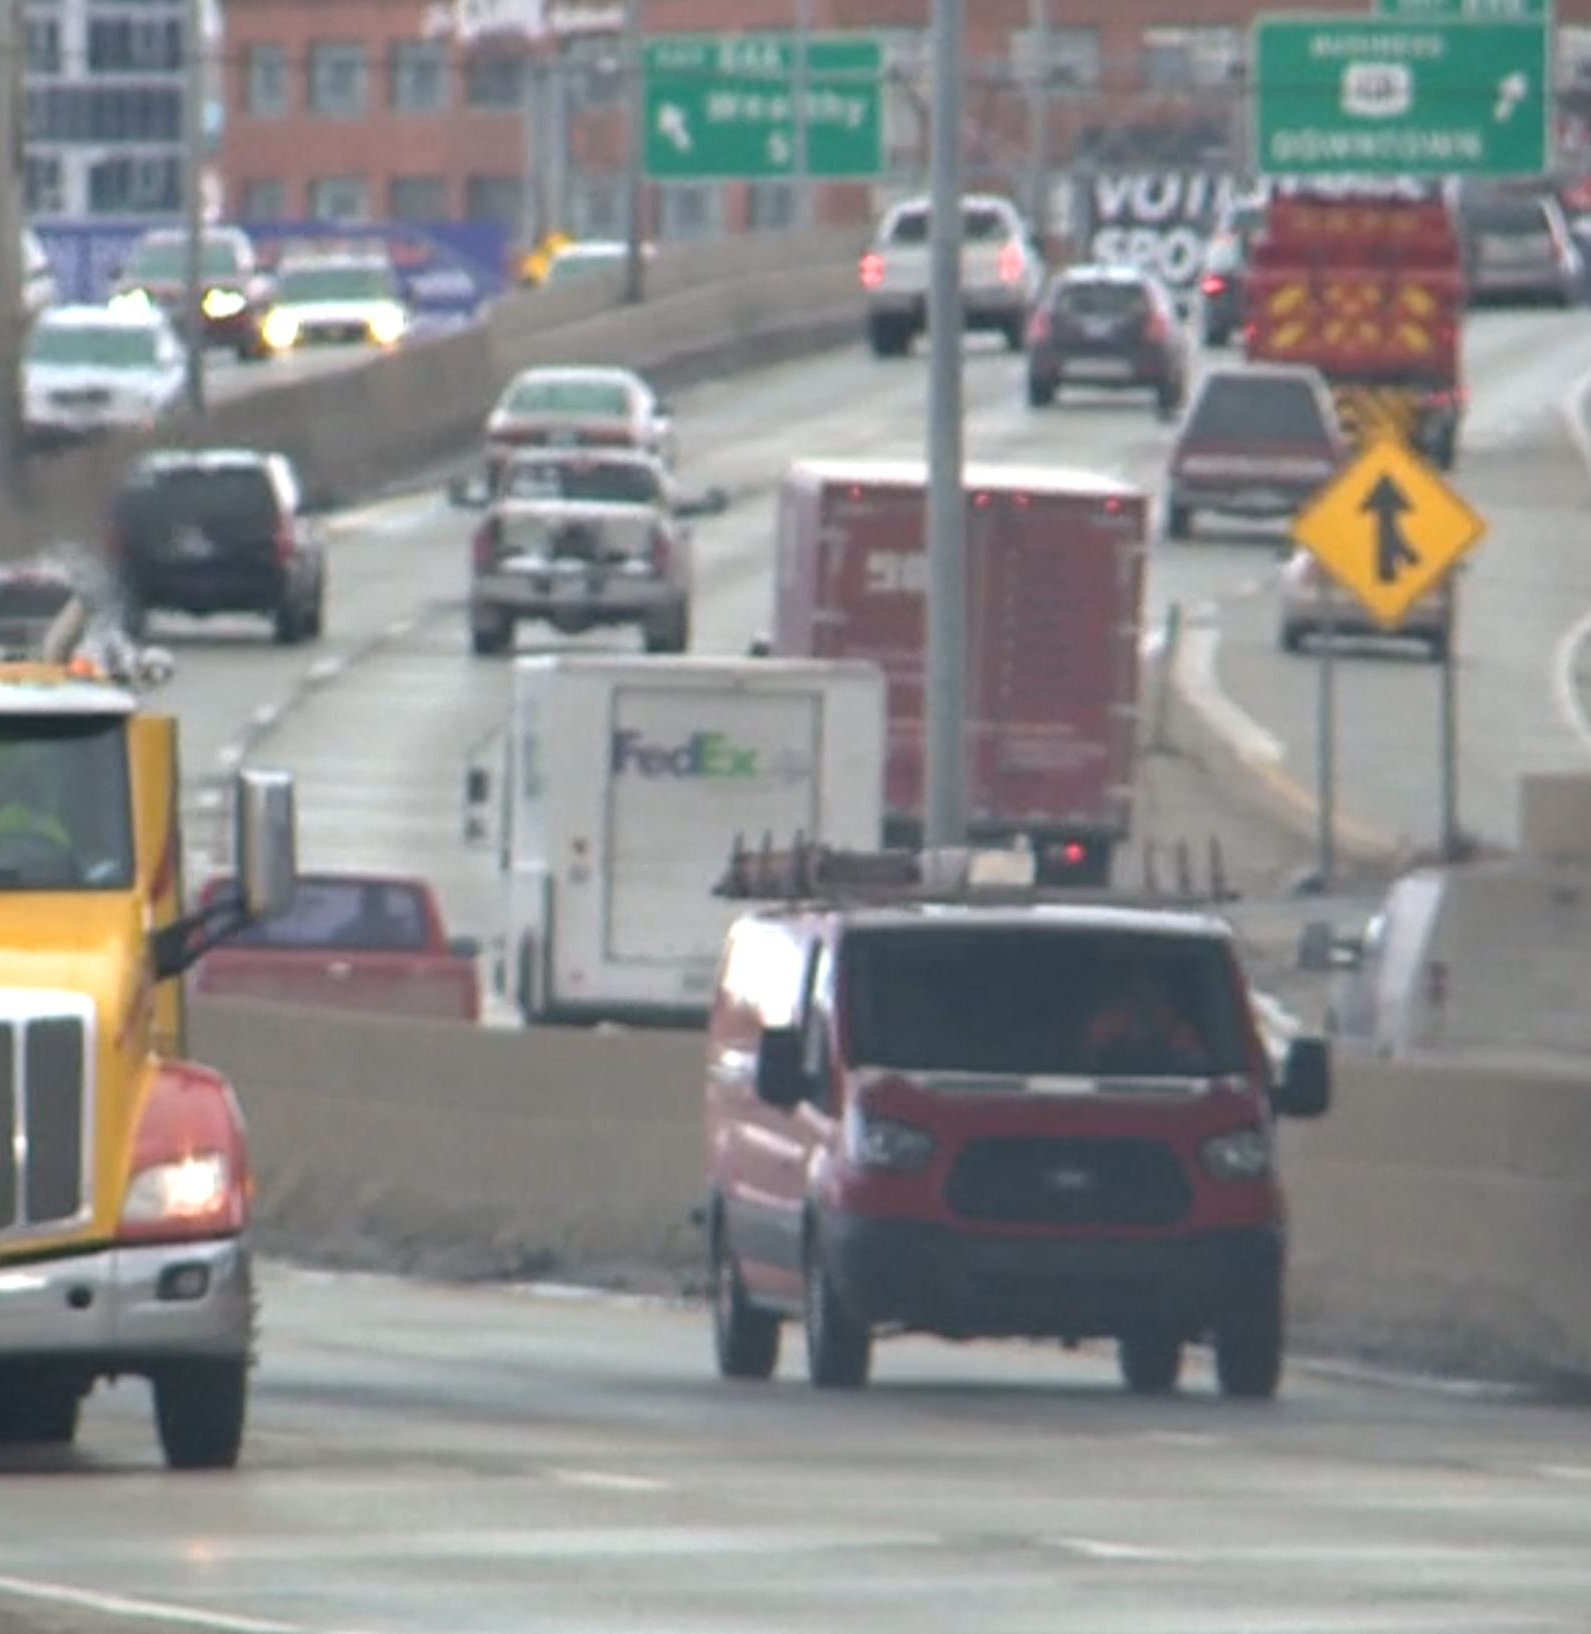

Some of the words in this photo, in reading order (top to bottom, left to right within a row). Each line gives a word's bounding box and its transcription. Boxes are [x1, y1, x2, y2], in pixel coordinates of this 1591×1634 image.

[706, 91, 866, 129] Weathy
[1270, 128, 1484, 161] DOWNTOWN
[611, 729, 759, 780] FedEx
